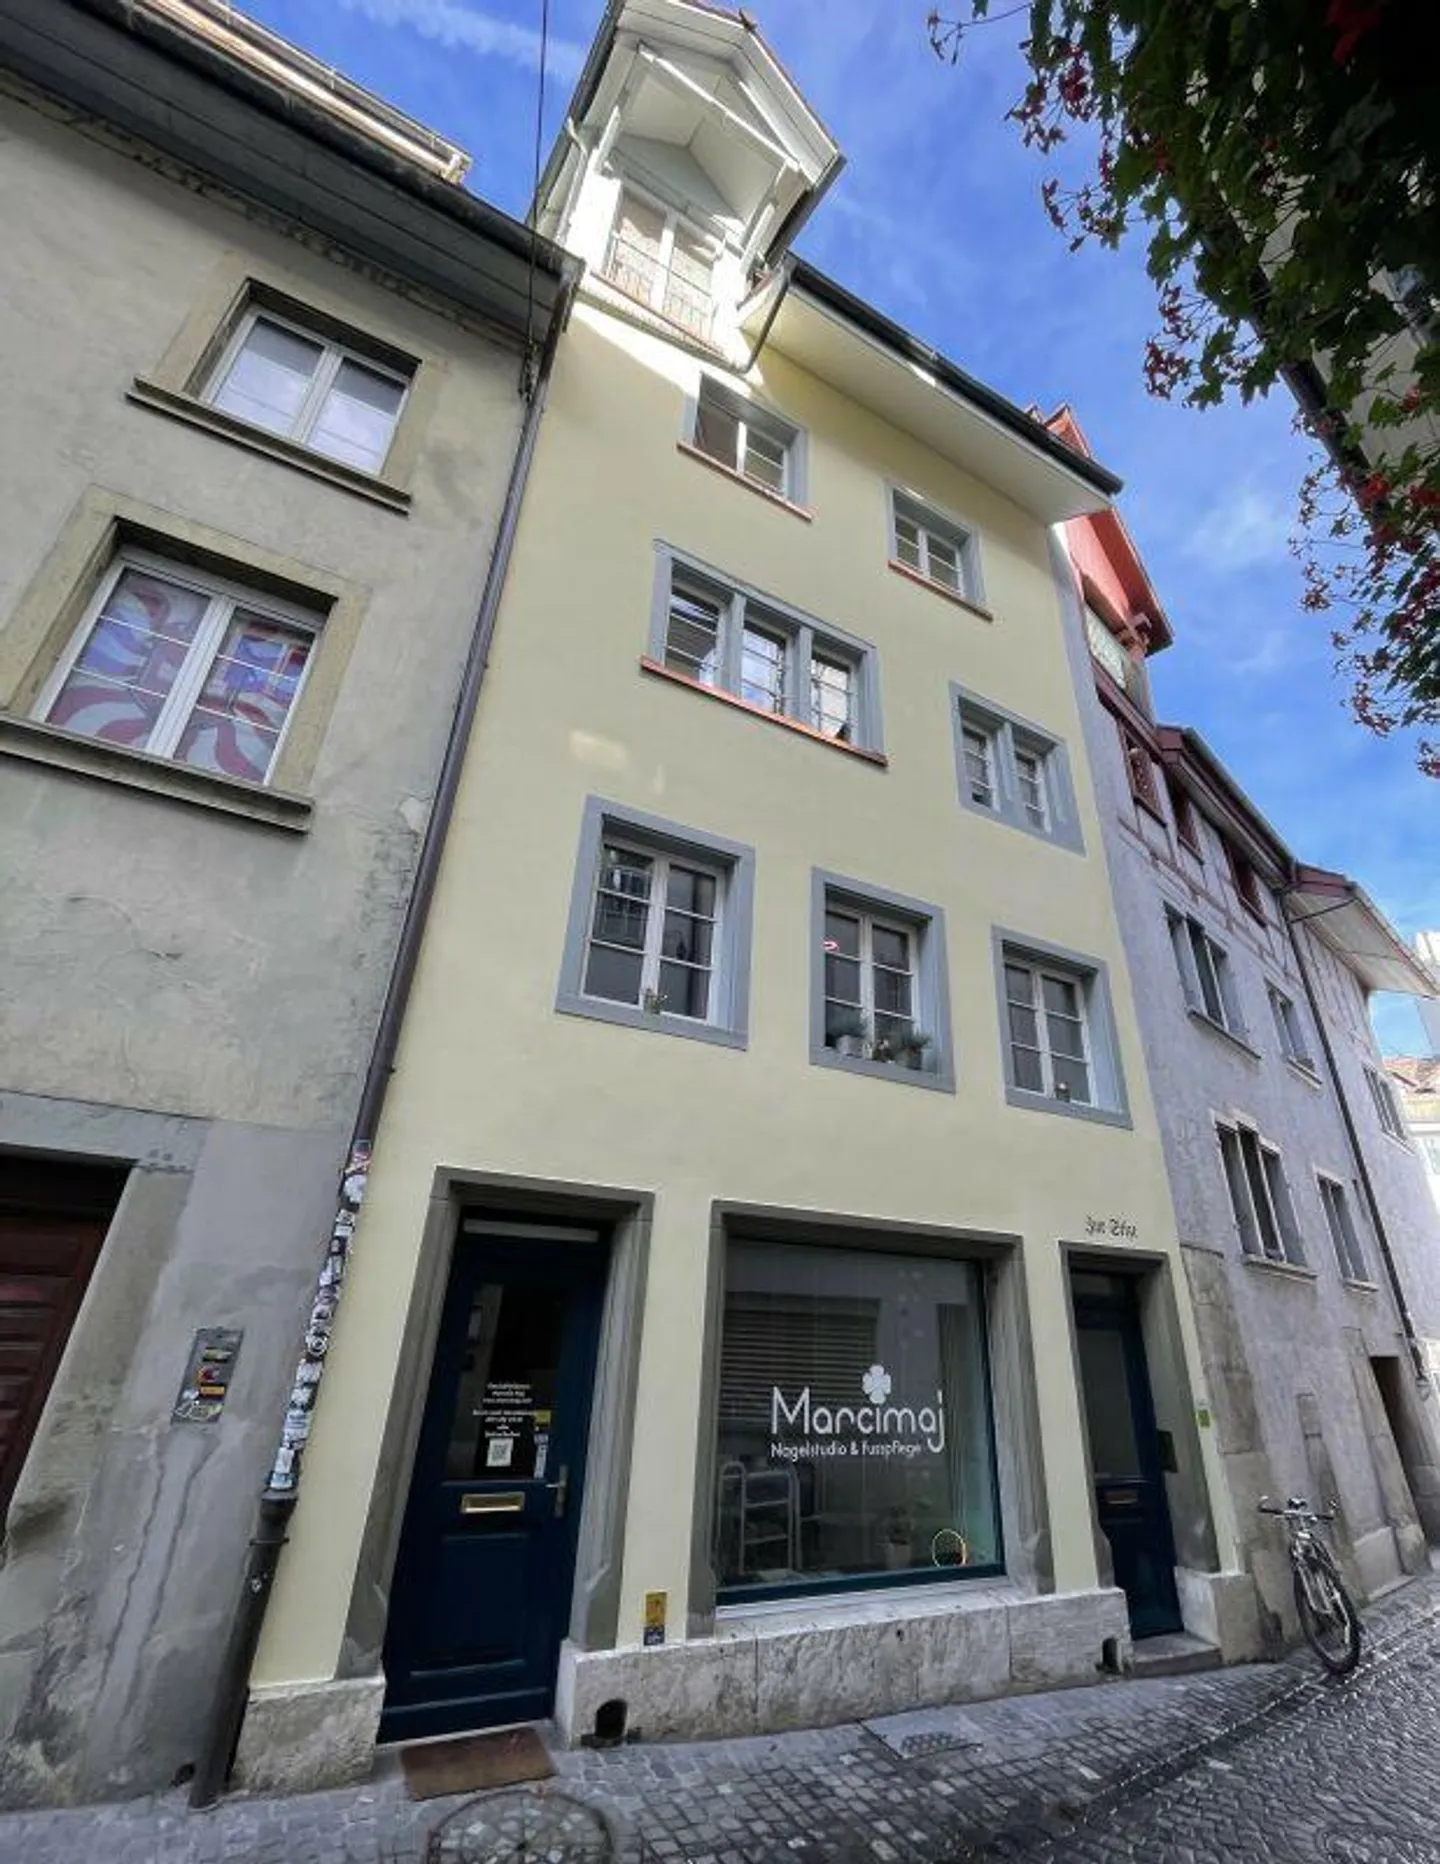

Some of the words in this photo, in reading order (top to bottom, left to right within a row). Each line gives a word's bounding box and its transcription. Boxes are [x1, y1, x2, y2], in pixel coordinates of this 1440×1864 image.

[771, 1385, 945, 1453] Marcimaj
[770, 1440, 847, 1462] Nagelstudio
[849, 1440, 859, 1456] &
